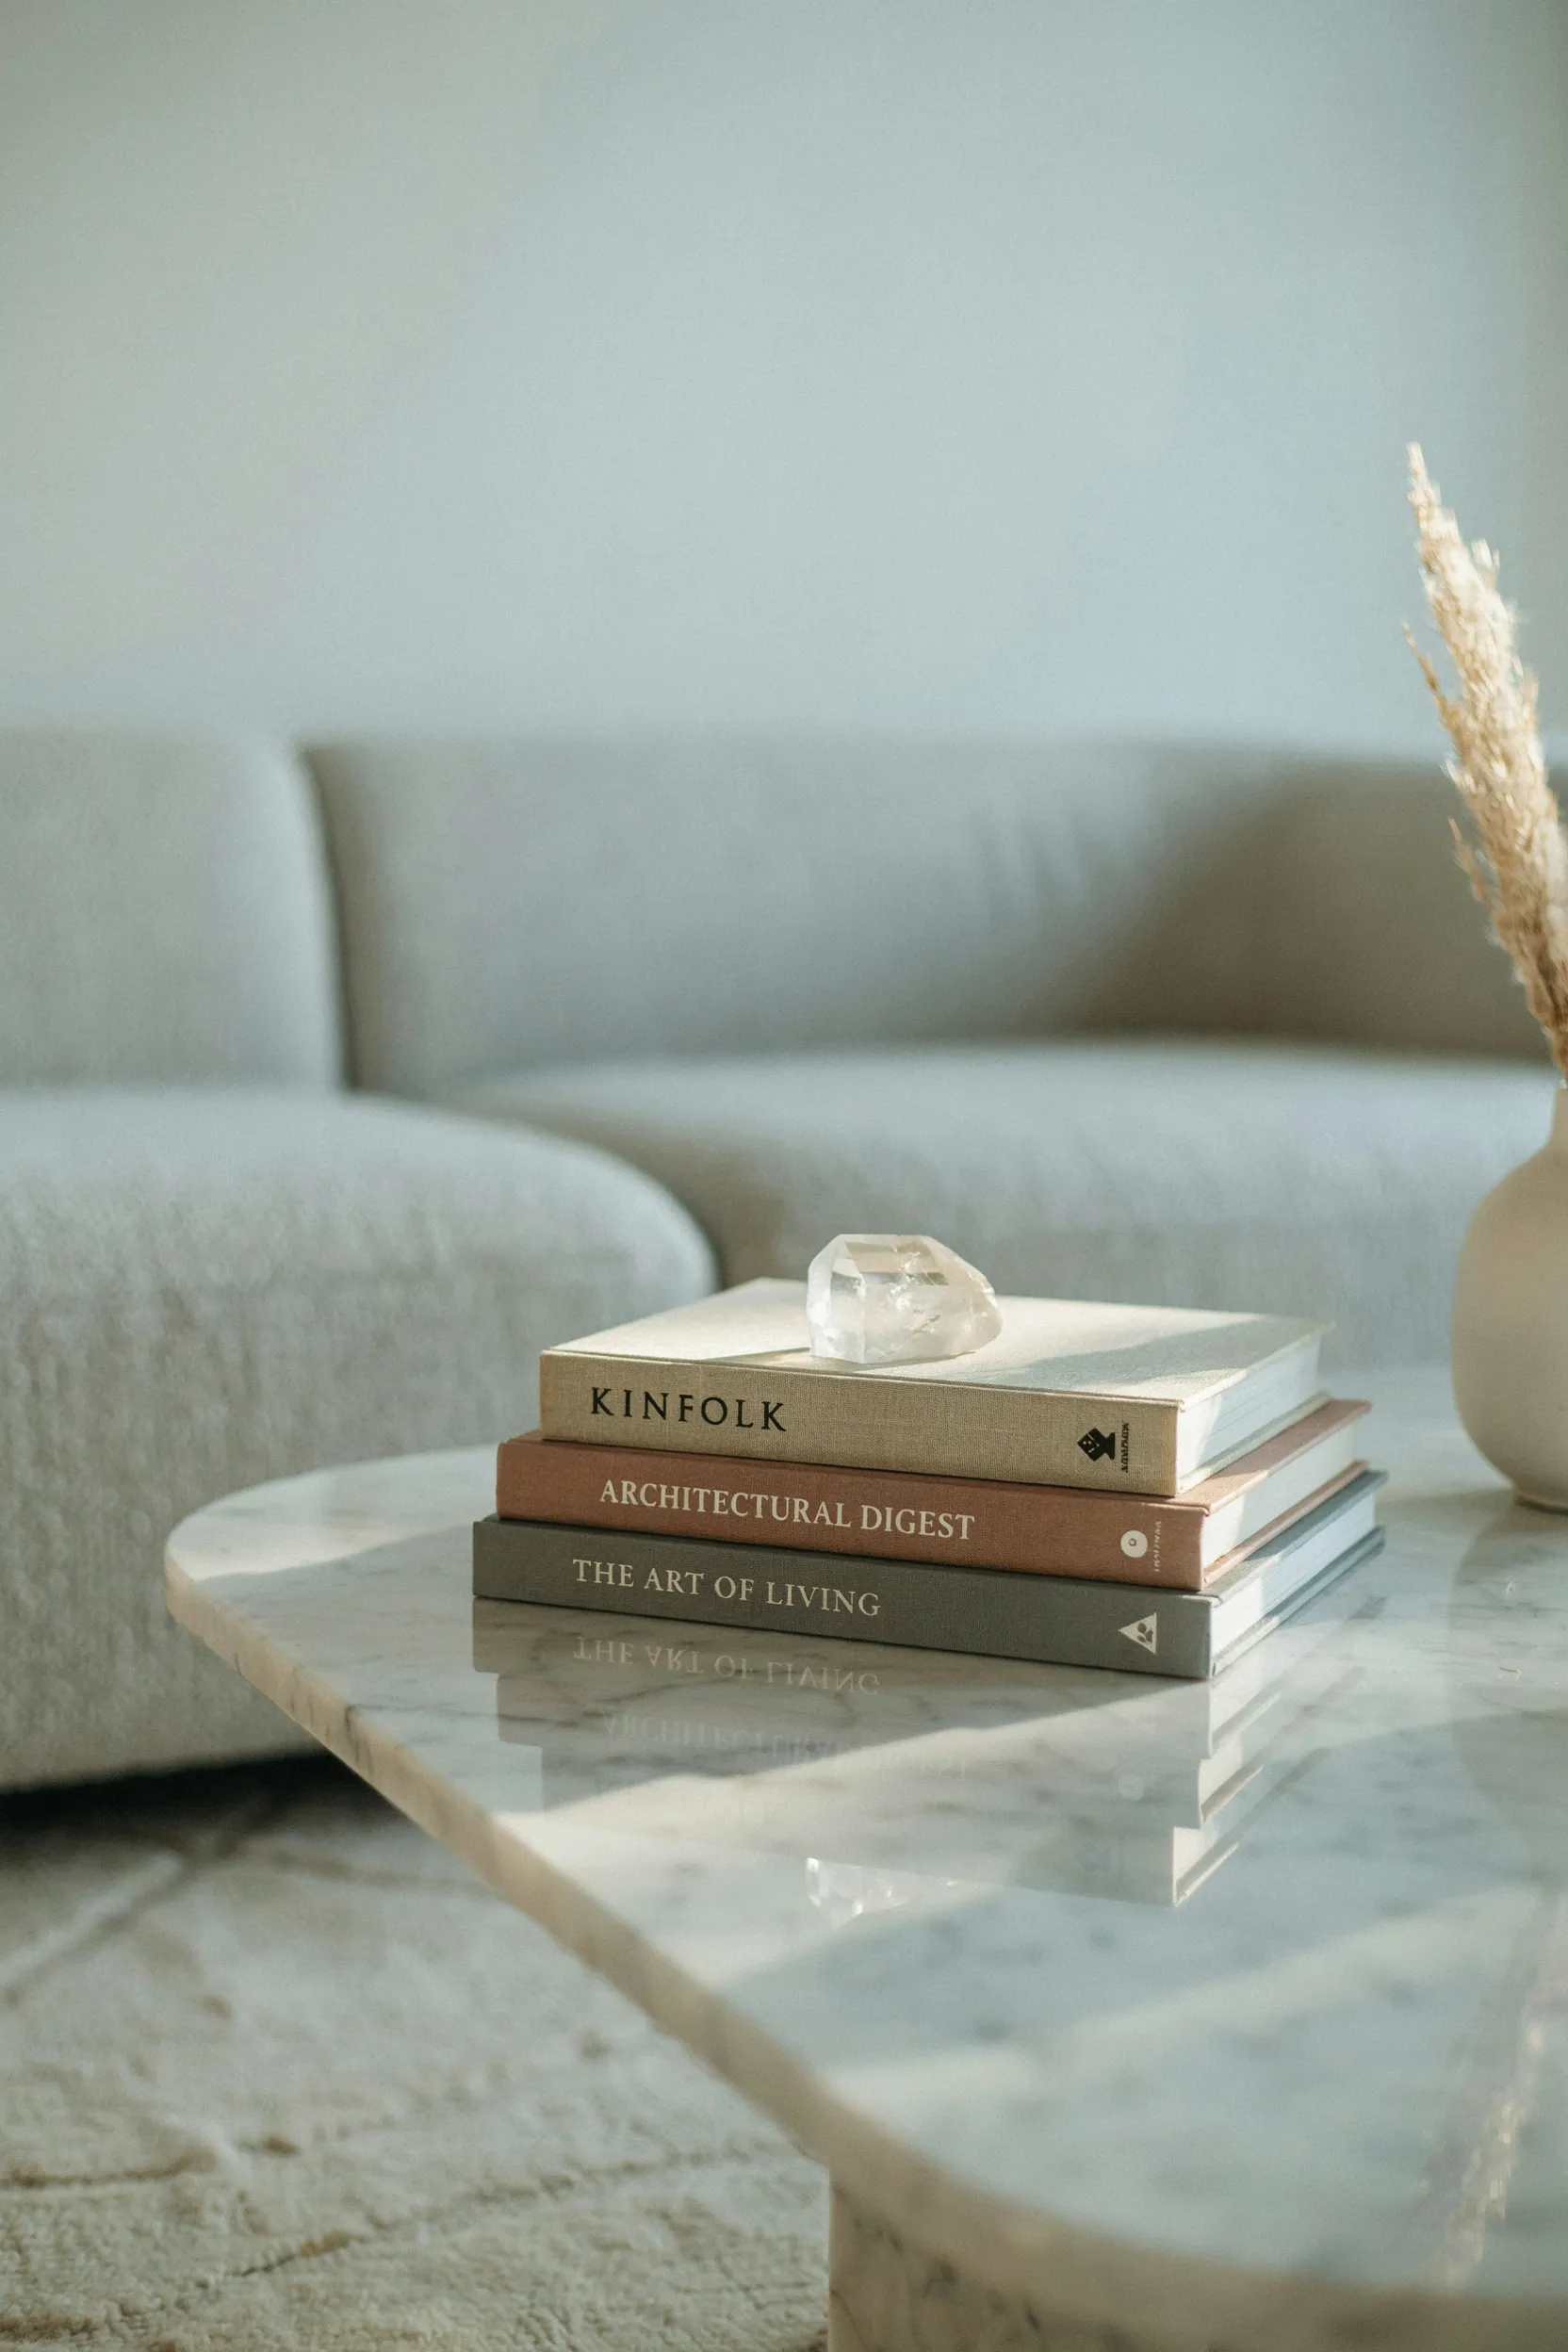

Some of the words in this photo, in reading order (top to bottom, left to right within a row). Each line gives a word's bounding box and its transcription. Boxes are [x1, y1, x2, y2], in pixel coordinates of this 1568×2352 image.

[590, 1387, 786, 1431] KINFOLK
[600, 1479, 851, 1527] ARCHITECTURAL
[860, 1505, 974, 1539] DIGEST
[572, 1559, 634, 1587] THE
[645, 1567, 705, 1595] ART
[714, 1576, 755, 1601] OF
[766, 1582, 880, 1616] LIVING
